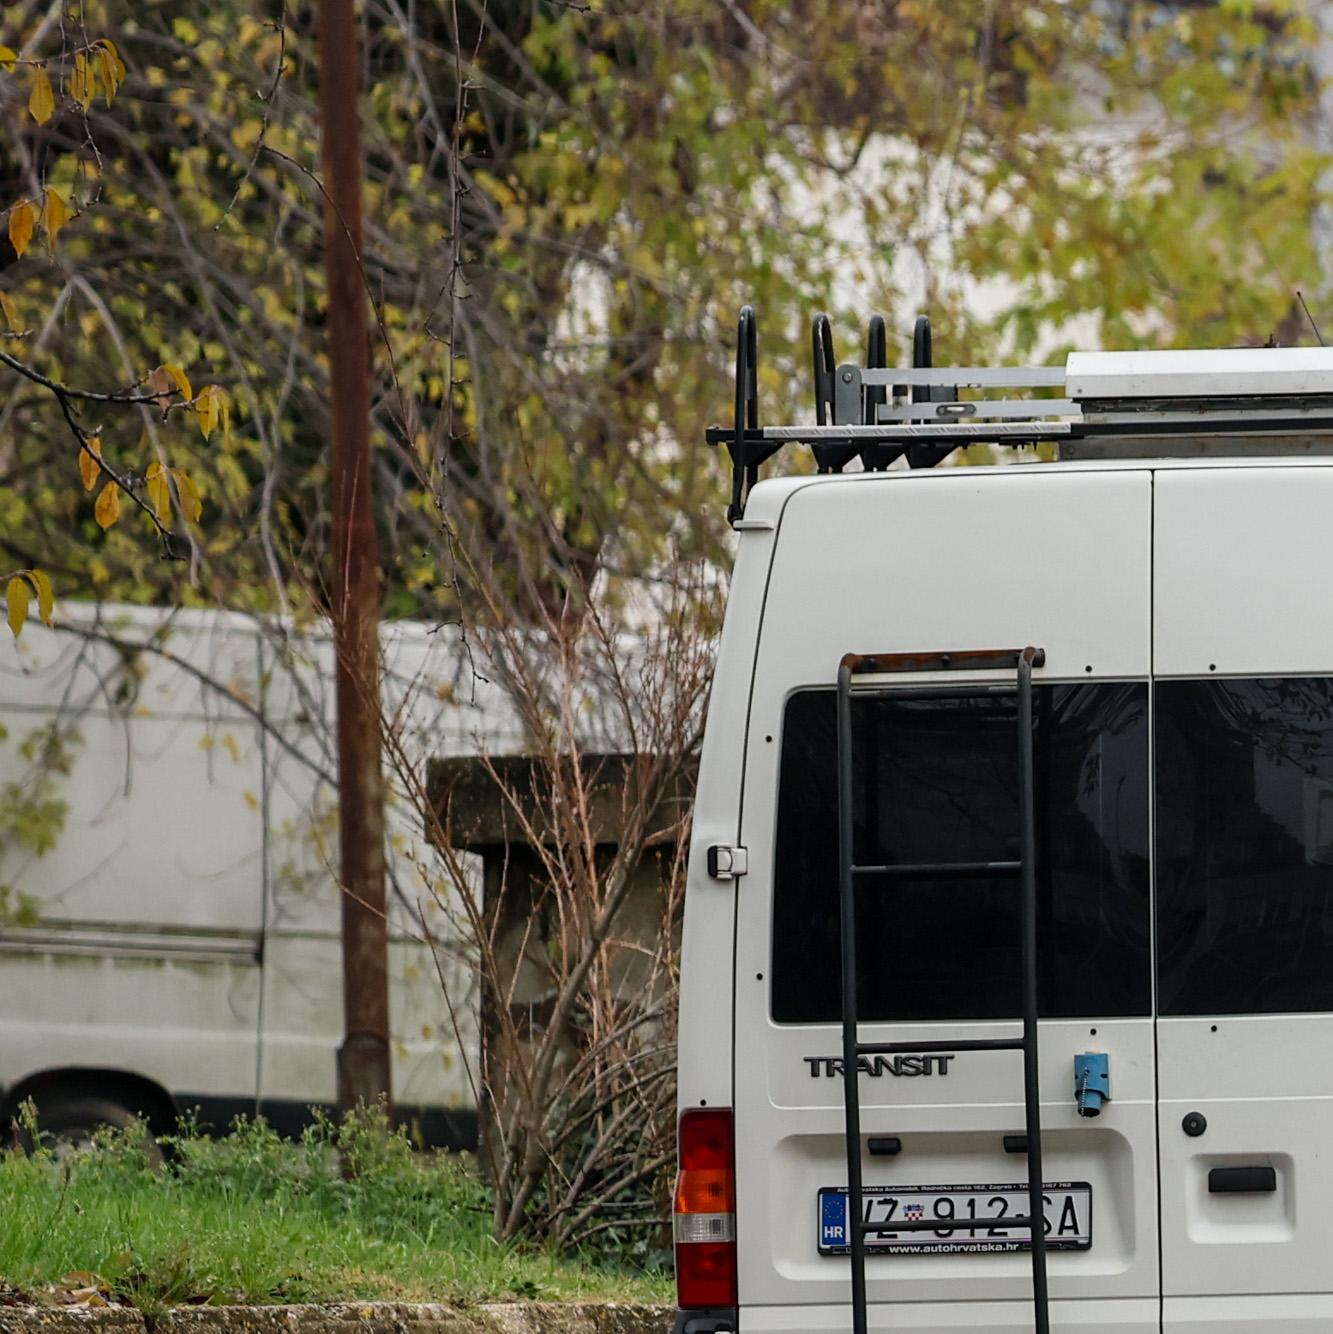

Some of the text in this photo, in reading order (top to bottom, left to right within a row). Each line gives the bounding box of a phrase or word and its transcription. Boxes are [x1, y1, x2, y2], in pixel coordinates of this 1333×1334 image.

[803, 1054, 955, 1077] TRANSIT
[824, 1226, 844, 1239] HR
[888, 1242, 1019, 1254] www.autohrvatska.hr
